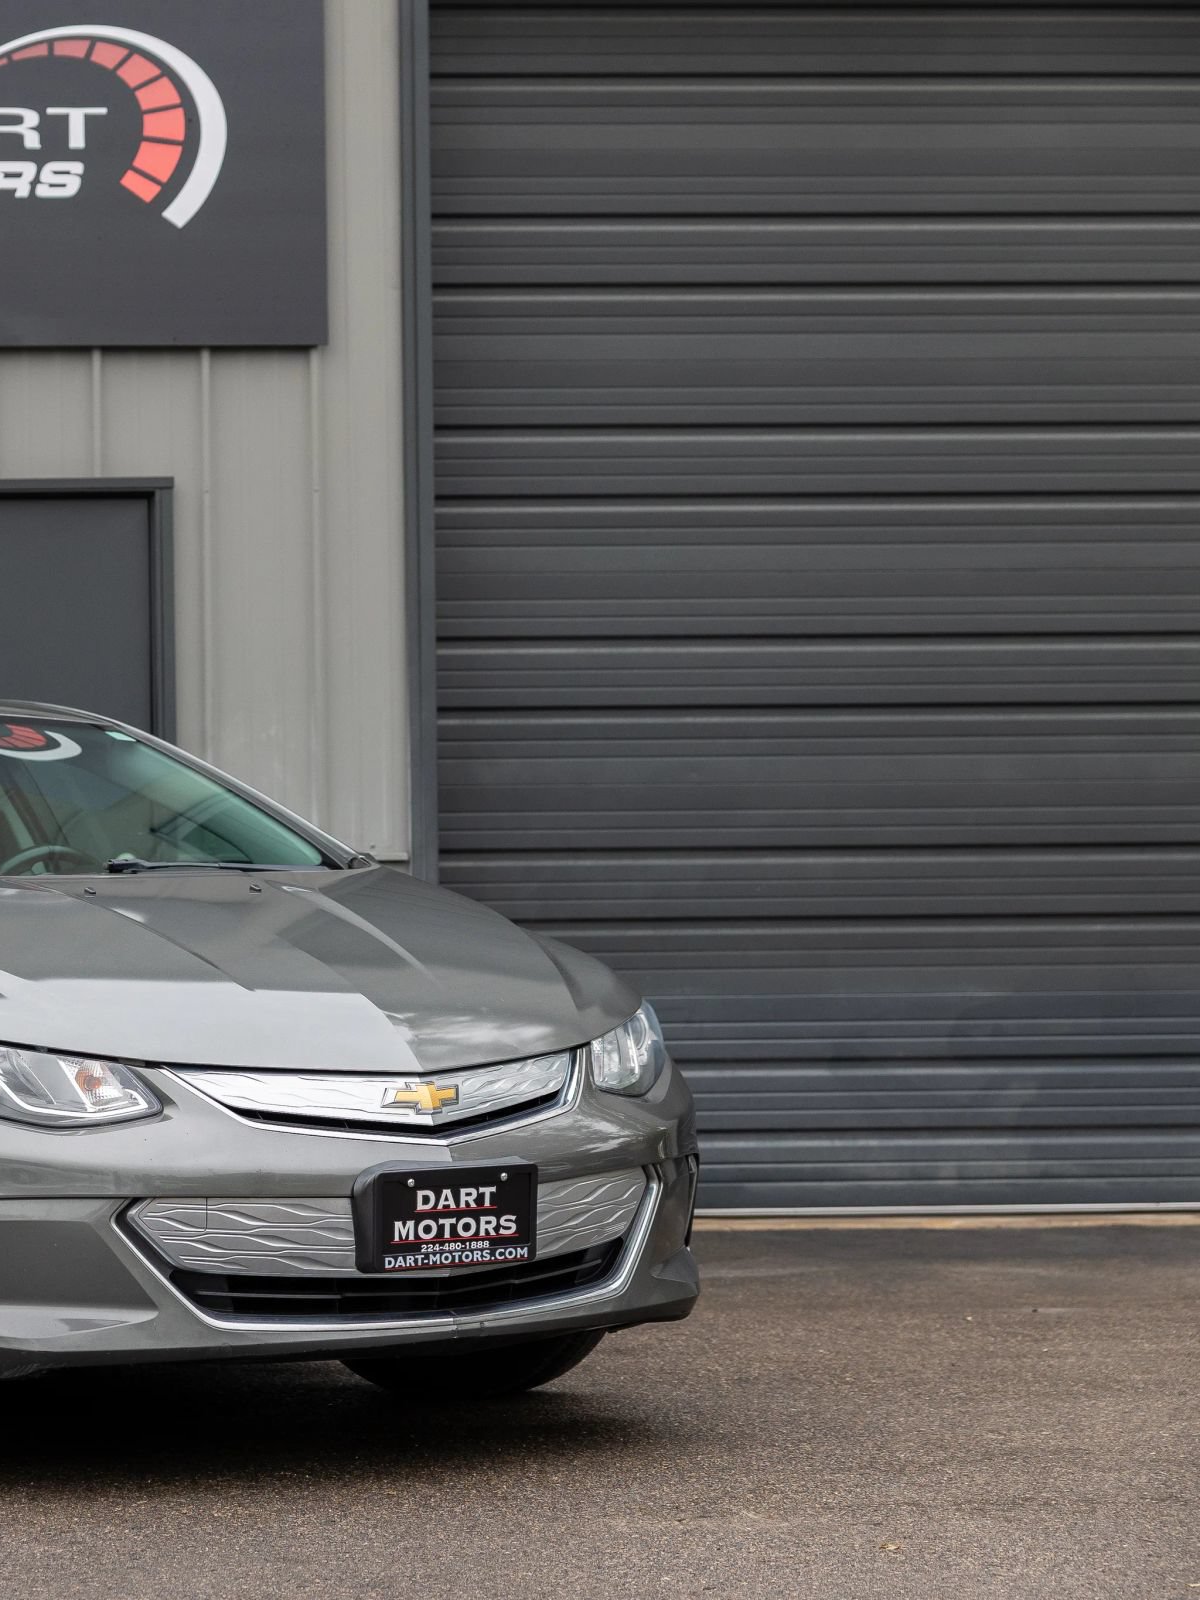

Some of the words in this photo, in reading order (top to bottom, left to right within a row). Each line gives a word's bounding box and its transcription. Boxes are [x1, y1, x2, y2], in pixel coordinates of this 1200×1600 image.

[416, 1186, 497, 1211] DART
[393, 1214, 517, 1242] MOTORS
[384, 1246, 528, 1269] DART-MOTORS.COM
[420, 1240, 490, 1252] 224-480-1888
